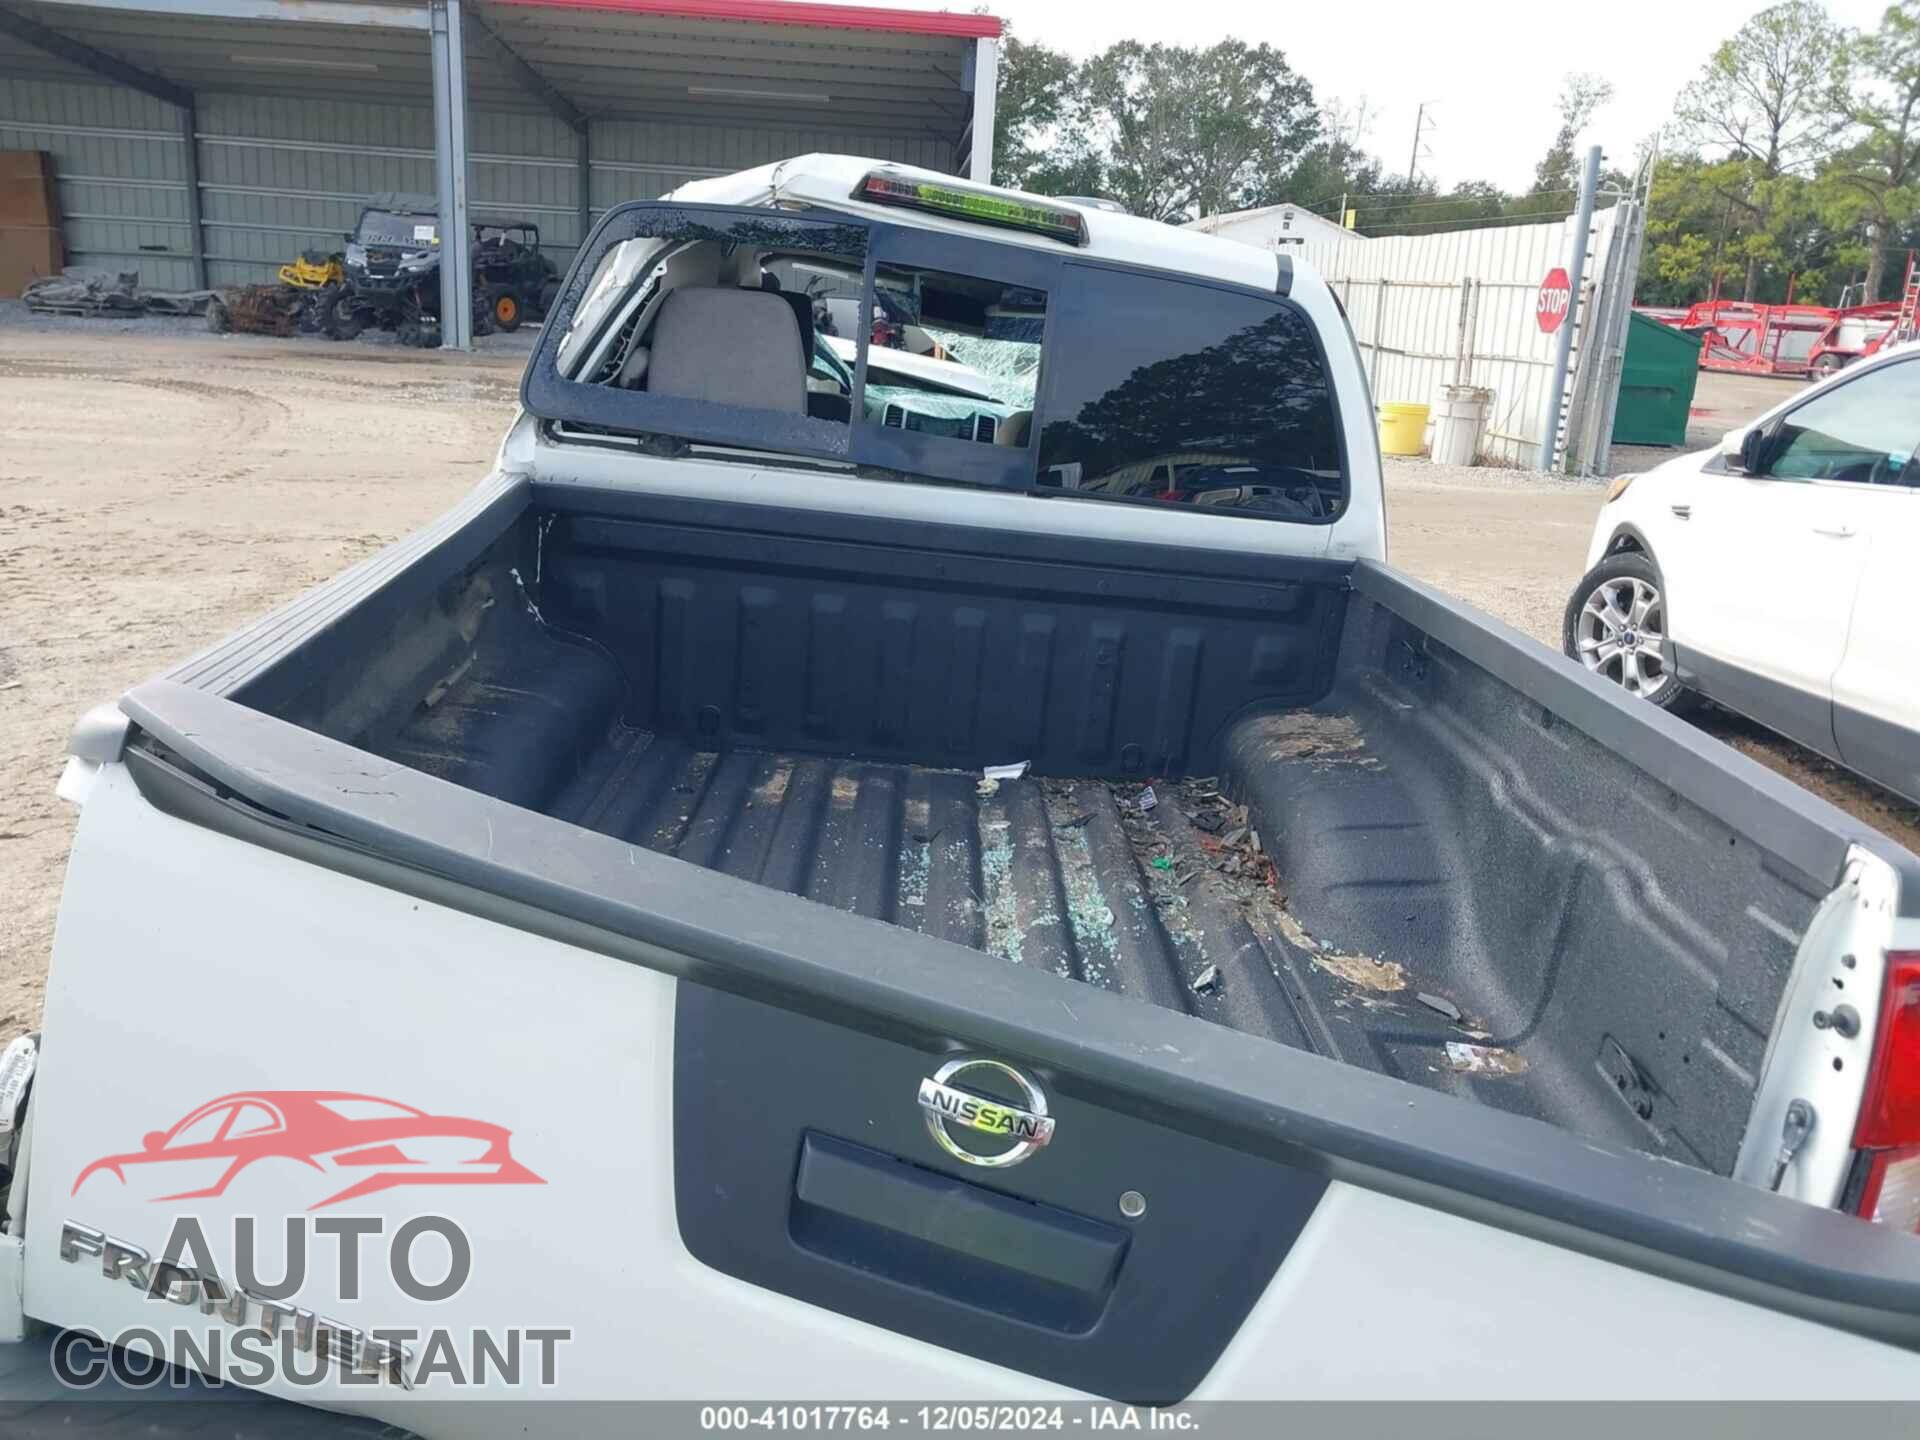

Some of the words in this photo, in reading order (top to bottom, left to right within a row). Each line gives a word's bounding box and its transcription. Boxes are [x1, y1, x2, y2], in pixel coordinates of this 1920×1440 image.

[1538, 288, 1569, 314] STOP
[933, 1090, 1038, 1137] NISSAN
[60, 1219, 414, 1390] FRONTIER
